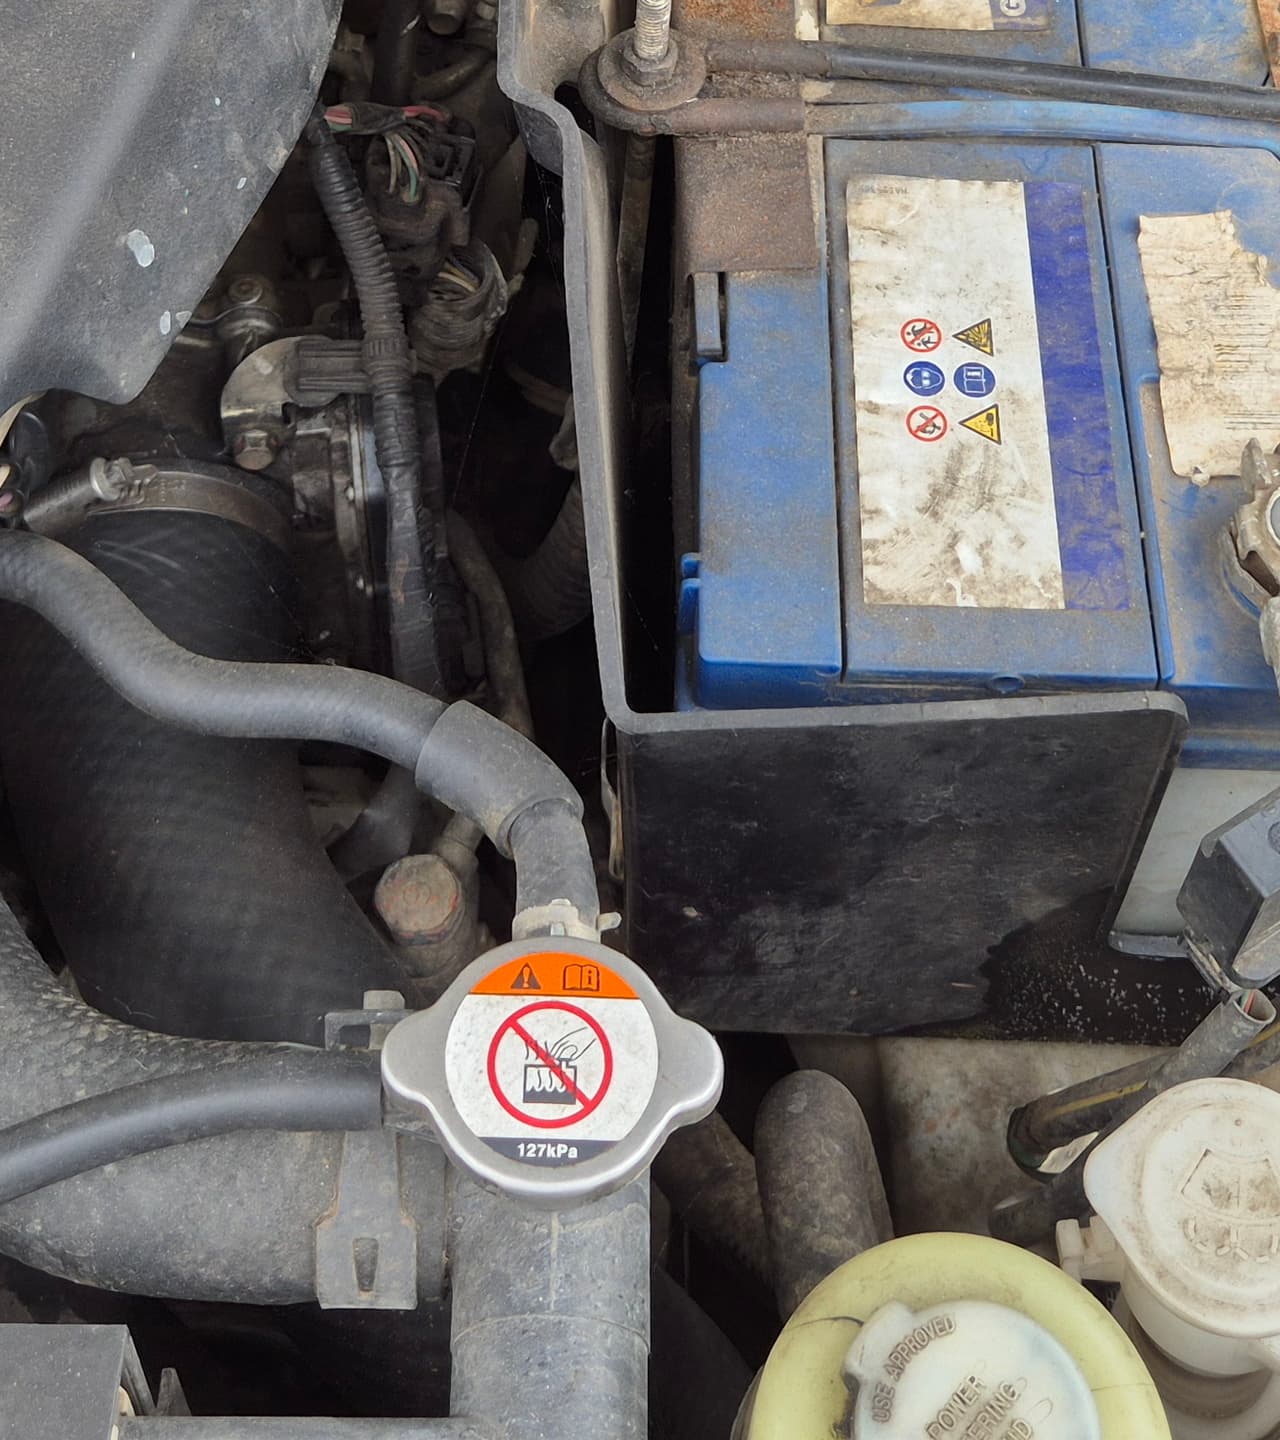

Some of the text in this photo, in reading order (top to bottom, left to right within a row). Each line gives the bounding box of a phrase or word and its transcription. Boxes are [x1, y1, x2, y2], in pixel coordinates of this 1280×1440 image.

[517, 1142, 578, 1159] 127kPa
[872, 1313, 957, 1424] USE APPROVED
[925, 1375, 986, 1440] POWER
